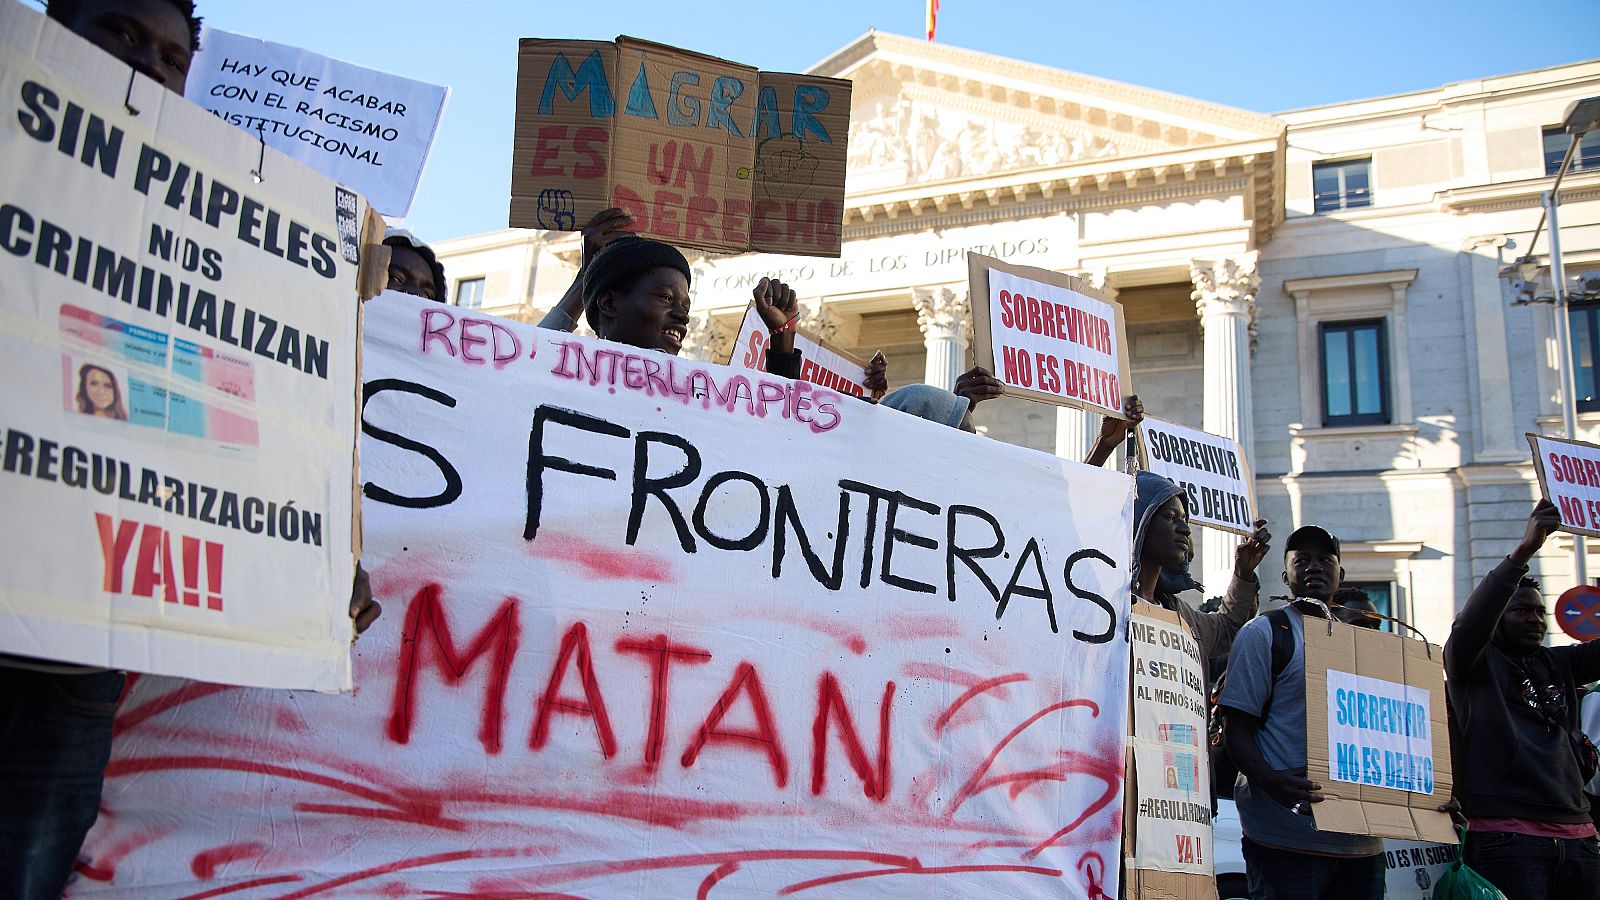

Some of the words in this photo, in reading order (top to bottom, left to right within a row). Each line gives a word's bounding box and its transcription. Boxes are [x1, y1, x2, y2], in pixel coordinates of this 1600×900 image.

[210, 84, 258, 103] CON
[263, 92, 288, 110] EL
[295, 101, 399, 142] RACISMO
[221, 58, 267, 77] HAY
[272, 69, 320, 91] QUE
[323, 86, 407, 117] ACABAR
[206, 108, 383, 166] NSTITUCIONAL
[531, 125, 610, 180] ES
[647, 139, 713, 197] UN
[18, 80, 124, 179] SIN
[134, 142, 338, 279] PAPELES
[613, 183, 838, 250] DERECHO
[149, 223, 223, 282] NOS
[830, 261, 854, 278] DE
[870, 255, 908, 273] LOS
[925, 237, 1049, 267] DIPUTADOS
[0, 204, 330, 380] CRIMINALIZAN
[421, 308, 522, 370] RED
[999, 289, 1112, 356] SOBREVIVIR
[1002, 345, 1033, 388] NO
[1035, 352, 1062, 394] ES
[1063, 358, 1121, 411] DELITO
[1148, 428, 1241, 481] SOBREVIVIR
[0, 428, 323, 547] REGULARIZACIÓN
[1200, 486, 1251, 528] DELITO
[1558, 495, 1586, 528] NO
[523, 403, 1118, 645] FRONTERAS
[95, 512, 225, 612] YA!!
[1131, 621, 1156, 645] ME
[386, 582, 898, 803] MATAN
[1136, 658, 1146, 676] A
[1149, 660, 1178, 682] SER
[1137, 685, 1152, 701] AL
[1154, 688, 1189, 709] MENOS
[1336, 688, 1427, 740] SOBREVIVIR
[1337, 742, 1359, 782] NO
[1362, 746, 1382, 785] ES
[1384, 750, 1433, 794] DELITO
[1396, 848, 1411, 868] ES
[1410, 847, 1427, 867] MI
